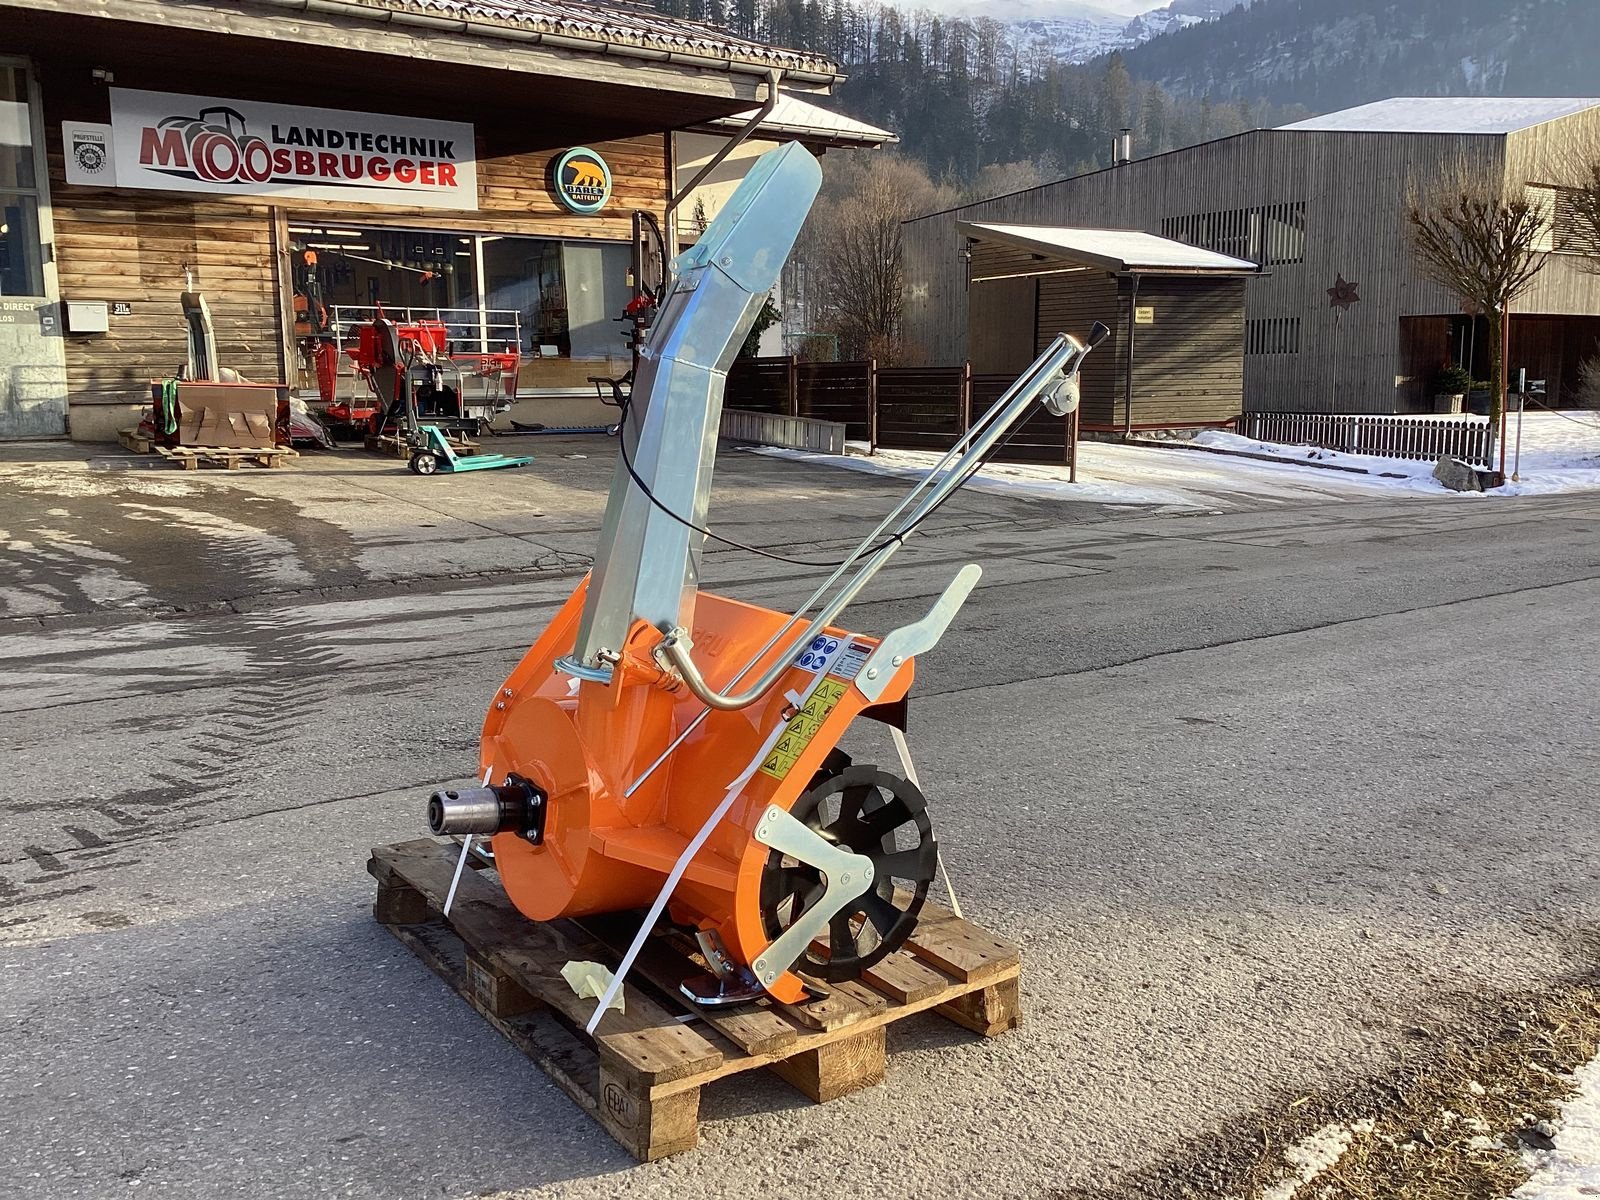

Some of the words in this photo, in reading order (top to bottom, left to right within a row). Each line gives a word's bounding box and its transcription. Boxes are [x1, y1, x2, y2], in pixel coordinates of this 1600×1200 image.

[140, 127, 458, 187] MOOSBRUGGER
[271, 124, 455, 159] LANDTECHNIK
[3, 302, 35, 311] DIRECT
